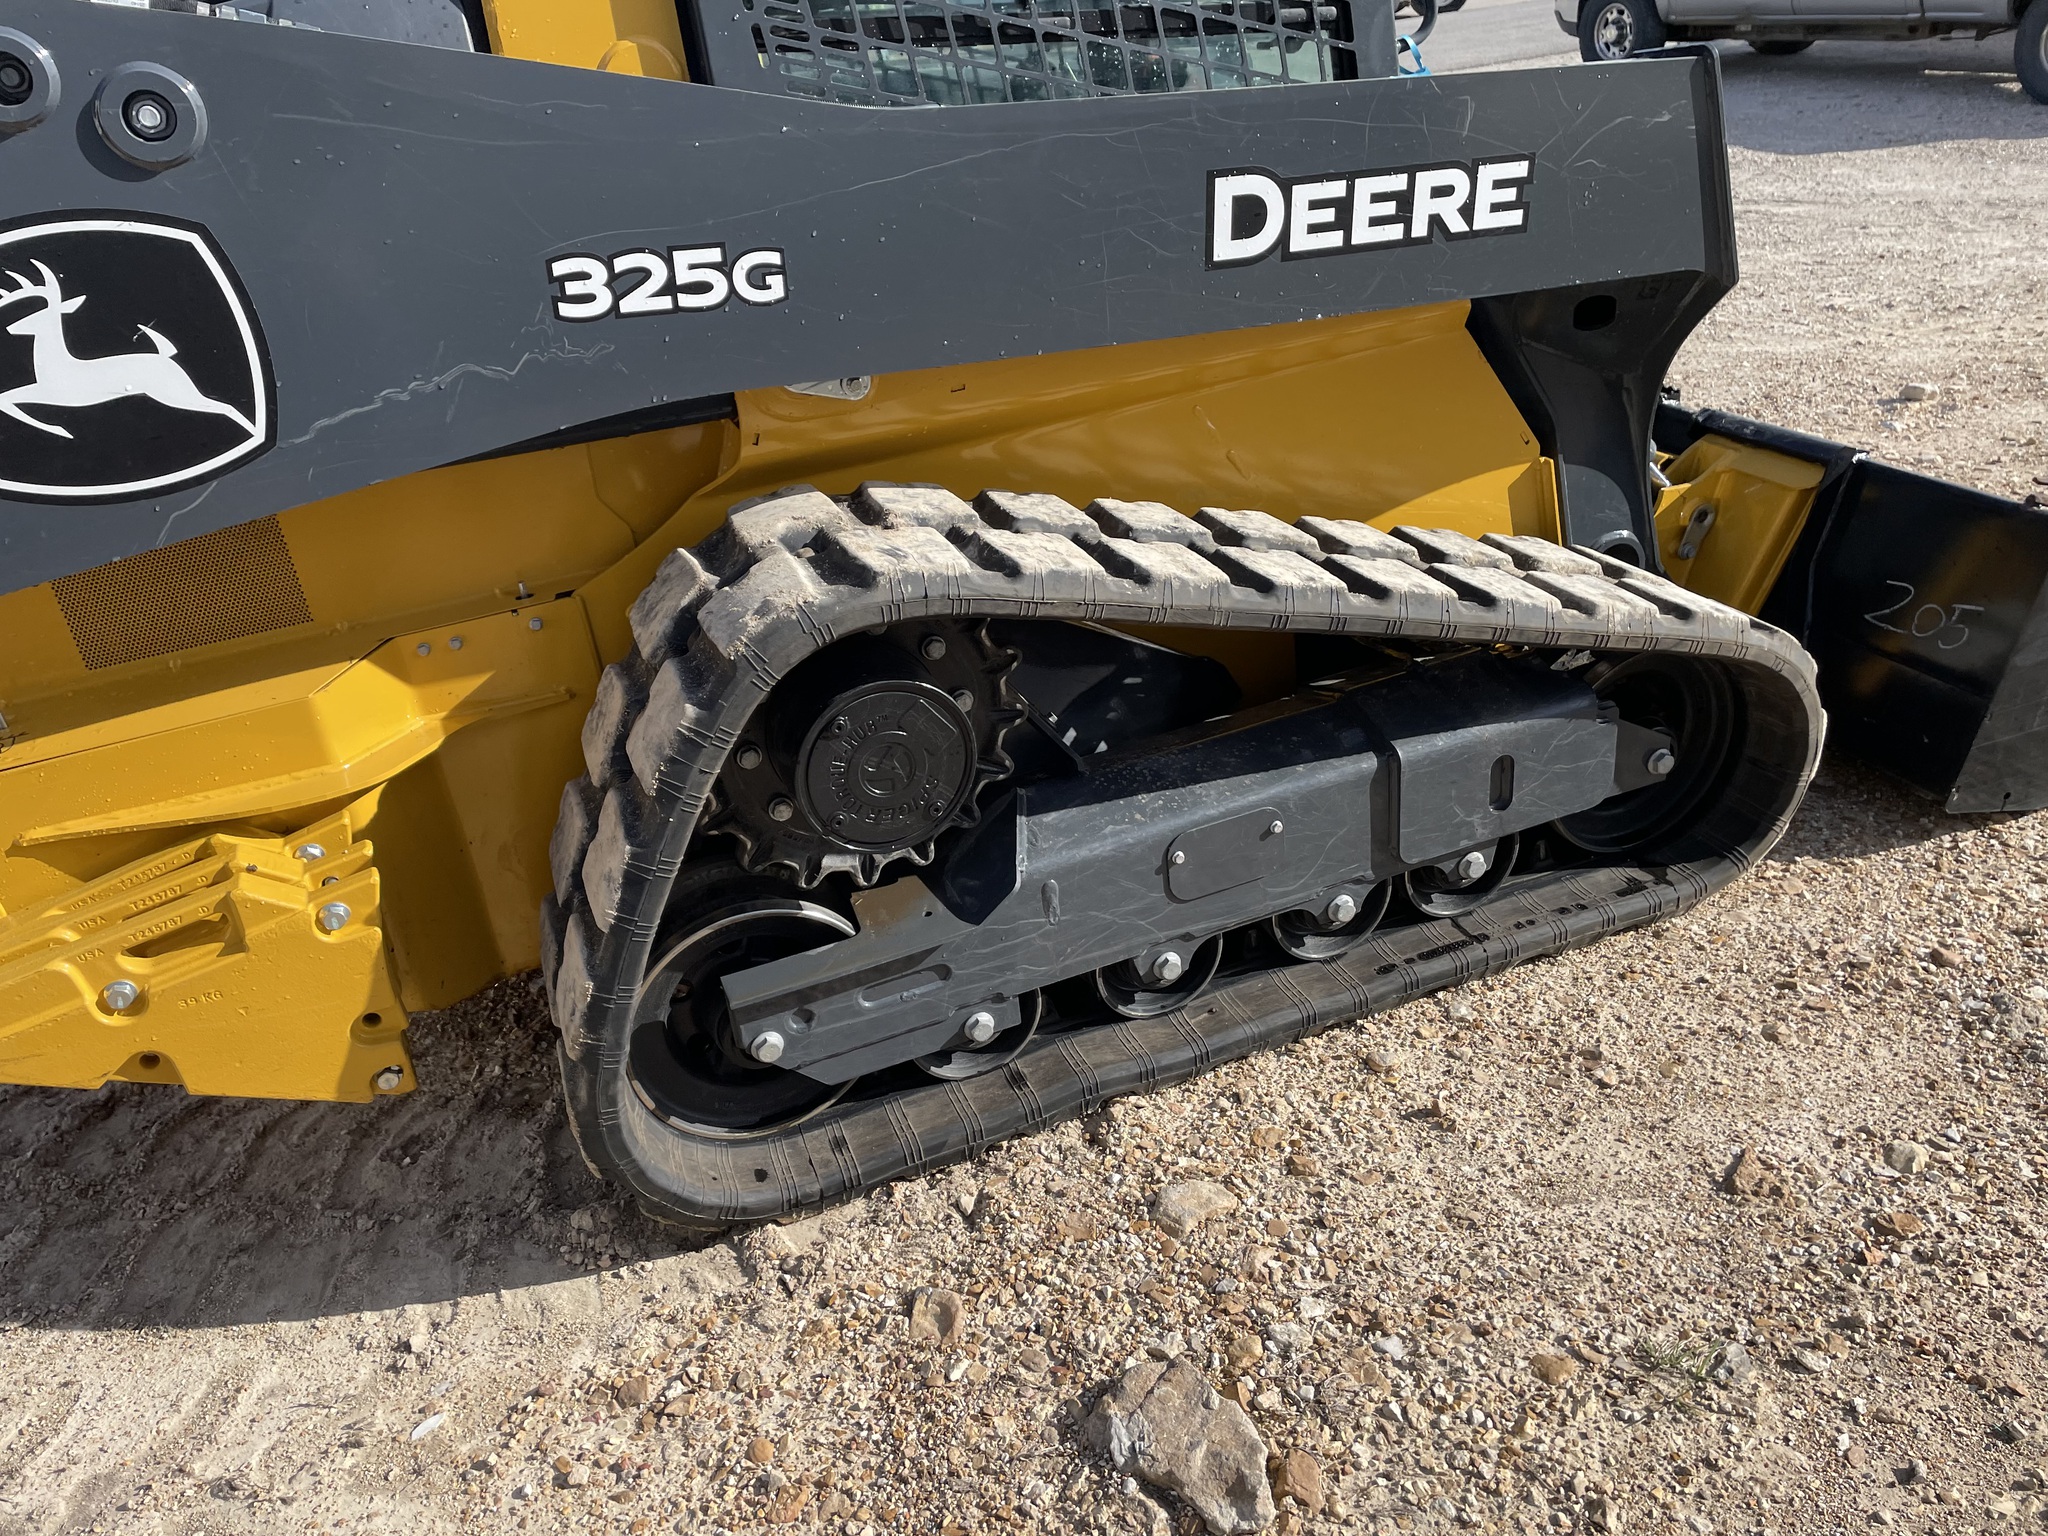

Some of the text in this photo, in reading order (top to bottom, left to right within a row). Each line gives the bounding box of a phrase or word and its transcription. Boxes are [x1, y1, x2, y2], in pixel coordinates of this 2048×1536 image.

[1213, 160, 1530, 262] DEERE
[551, 247, 786, 319] 325G
[1864, 579, 1985, 649] 205
[76, 947, 105, 964] USA
[78, 915, 107, 931] USA
